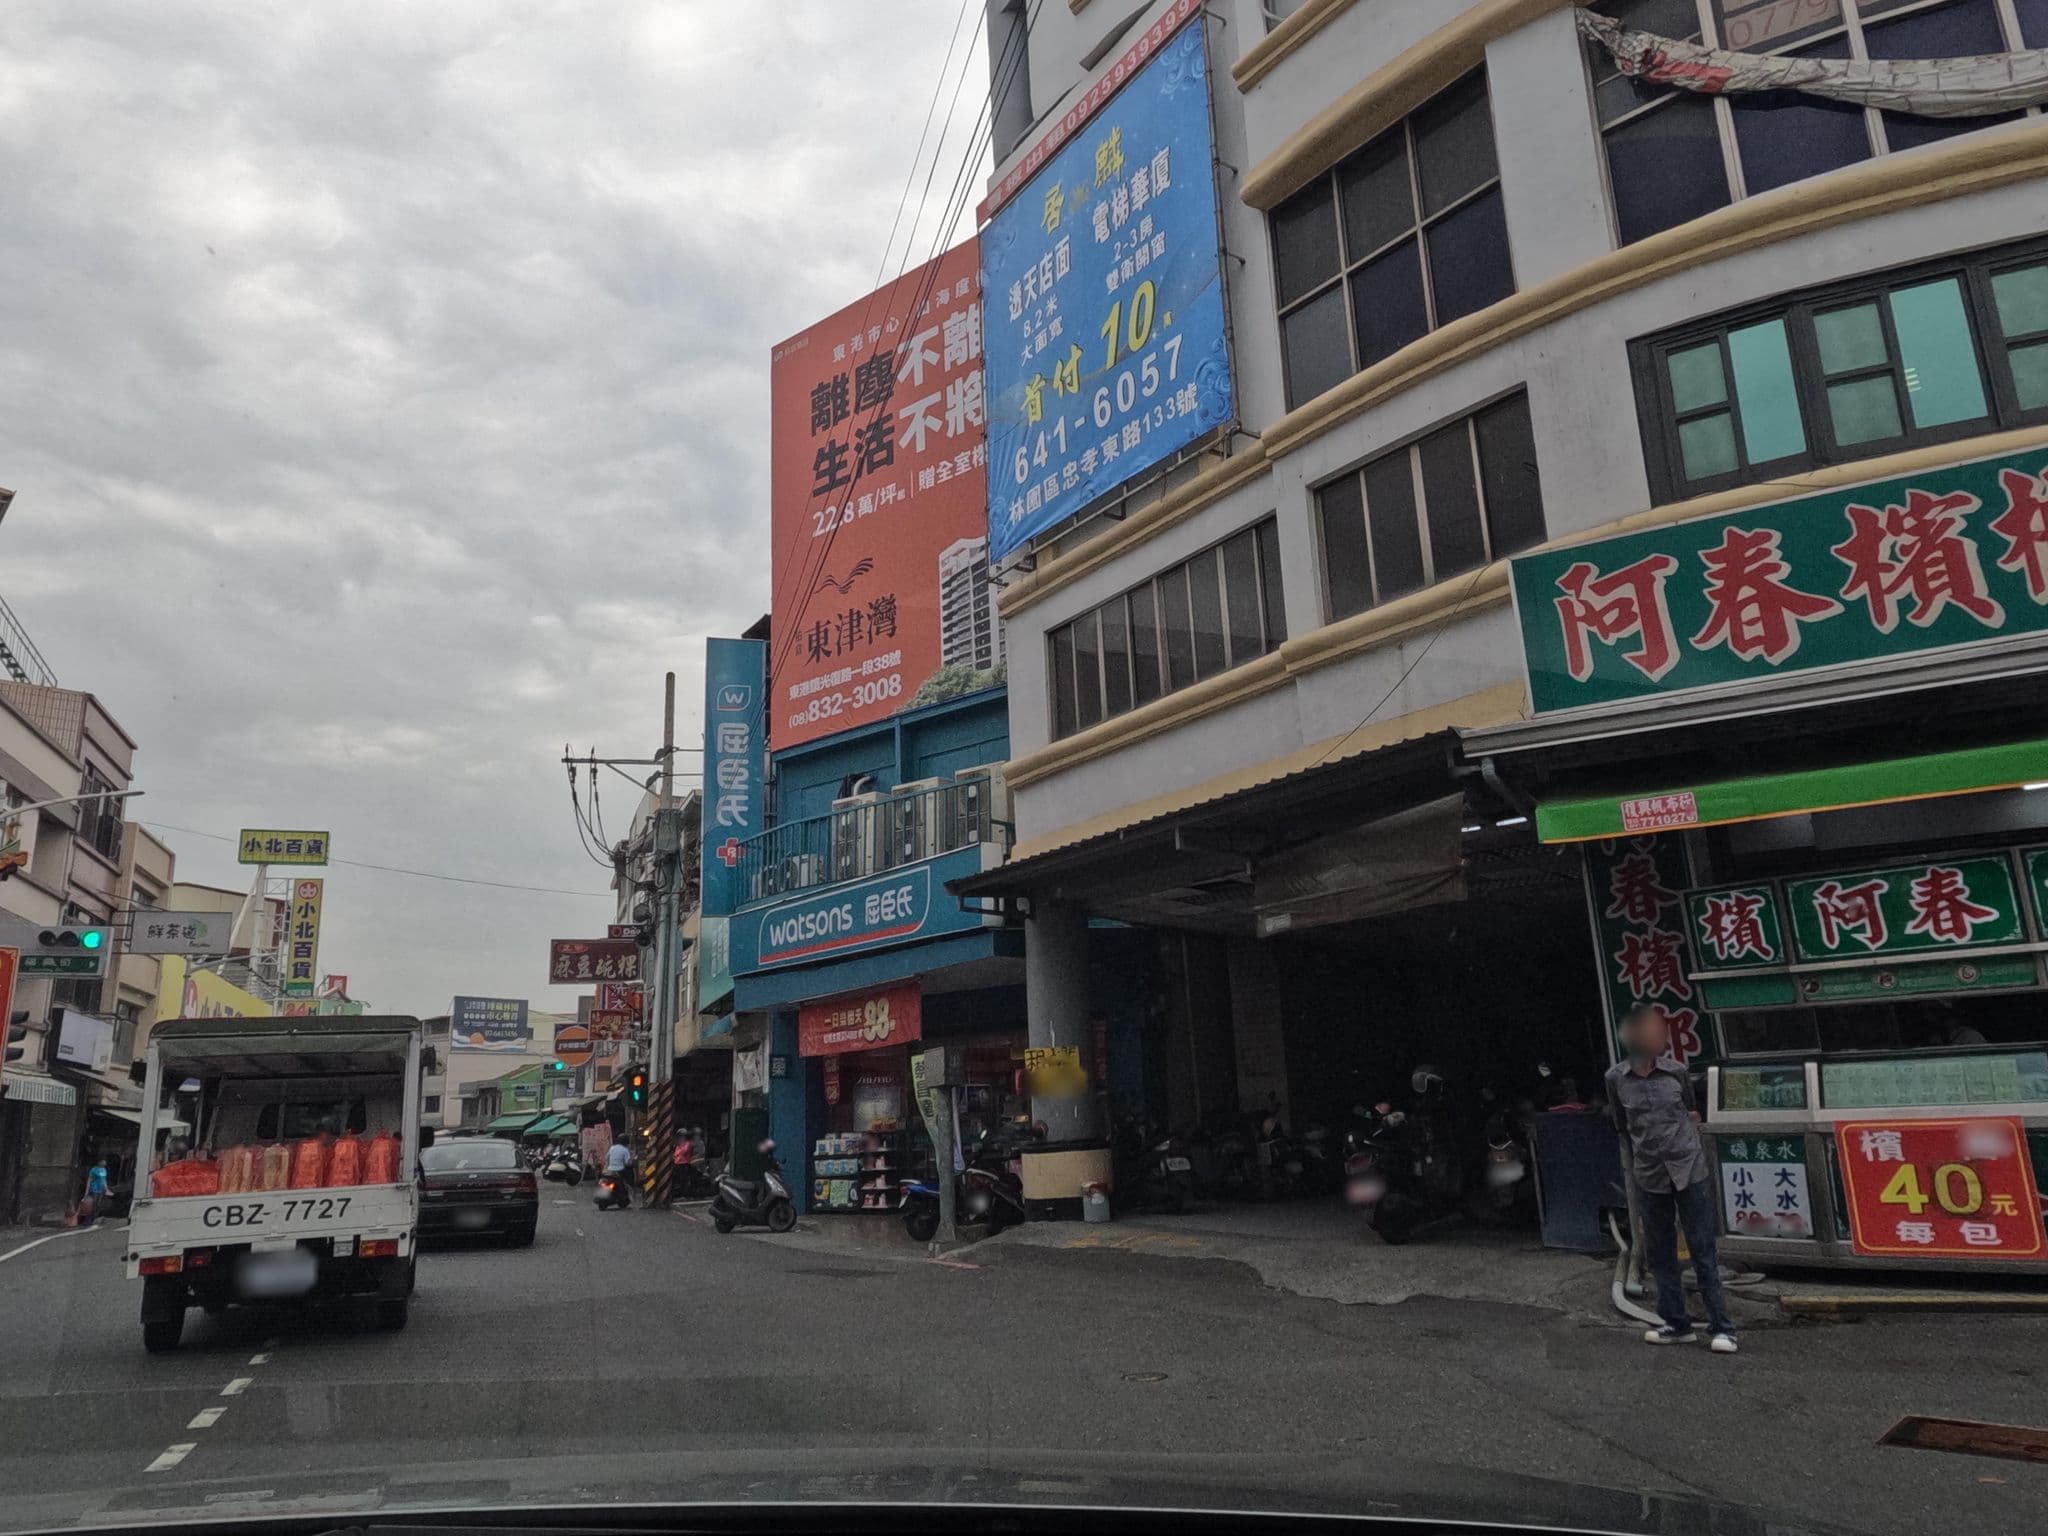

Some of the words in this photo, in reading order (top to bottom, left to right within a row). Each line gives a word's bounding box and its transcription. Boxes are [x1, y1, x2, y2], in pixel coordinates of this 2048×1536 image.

[1092, 145, 1171, 243] 電梯華廈
[1106, 231, 1167, 294] 雙衛開窗
[1113, 214, 1154, 262] 2-3房
[1008, 234, 1071, 322] 透天店面
[1020, 315, 1064, 367] 大面寬
[1023, 294, 1059, 338] 8.2米
[1014, 334, 1183, 485] 641-6057
[1020, 343, 1084, 427] 首付
[1009, 382, 1198, 526] 林園區忠孝東路133號
[803, 593, 897, 666] 東津灣
[788, 673, 902, 729] (08)832-3008
[716, 722, 750, 827] 屈臣氏
[243, 837, 323, 855] 小北百貨
[147, 922, 198, 940] 鮮茶道
[769, 903, 853, 947] watsons
[864, 885, 913, 926] 屈臣氏
[1698, 892, 1776, 960] 檳
[1814, 866, 2000, 950] 阿春
[292, 902, 316, 979] 小北百貨
[553, 954, 637, 979] 麻豆碗粿
[1896, 1221, 2002, 1246] 每包
